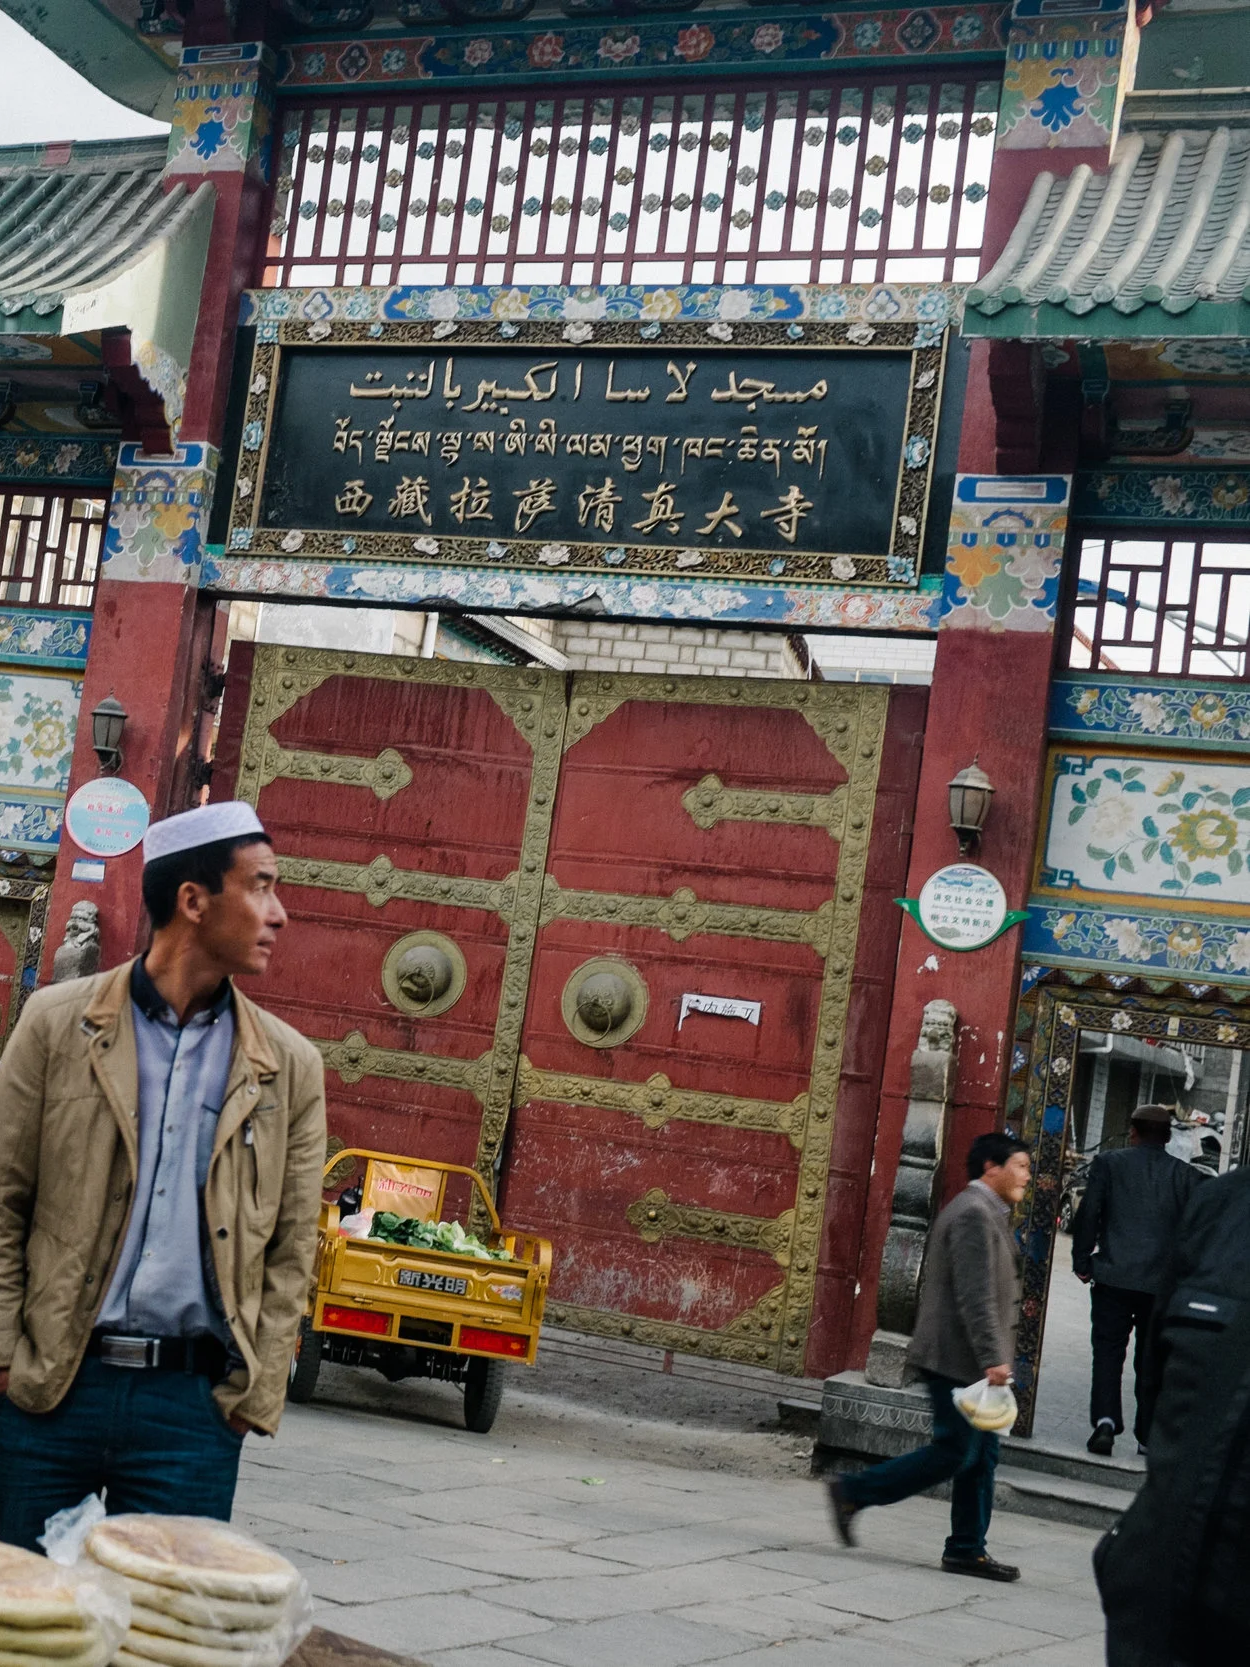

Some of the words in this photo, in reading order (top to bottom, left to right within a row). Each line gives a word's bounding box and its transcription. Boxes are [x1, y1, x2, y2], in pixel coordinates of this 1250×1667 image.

[334, 475, 814, 544] 西藏拉萨清真大寺
[399, 1270, 467, 1295] 新光明
